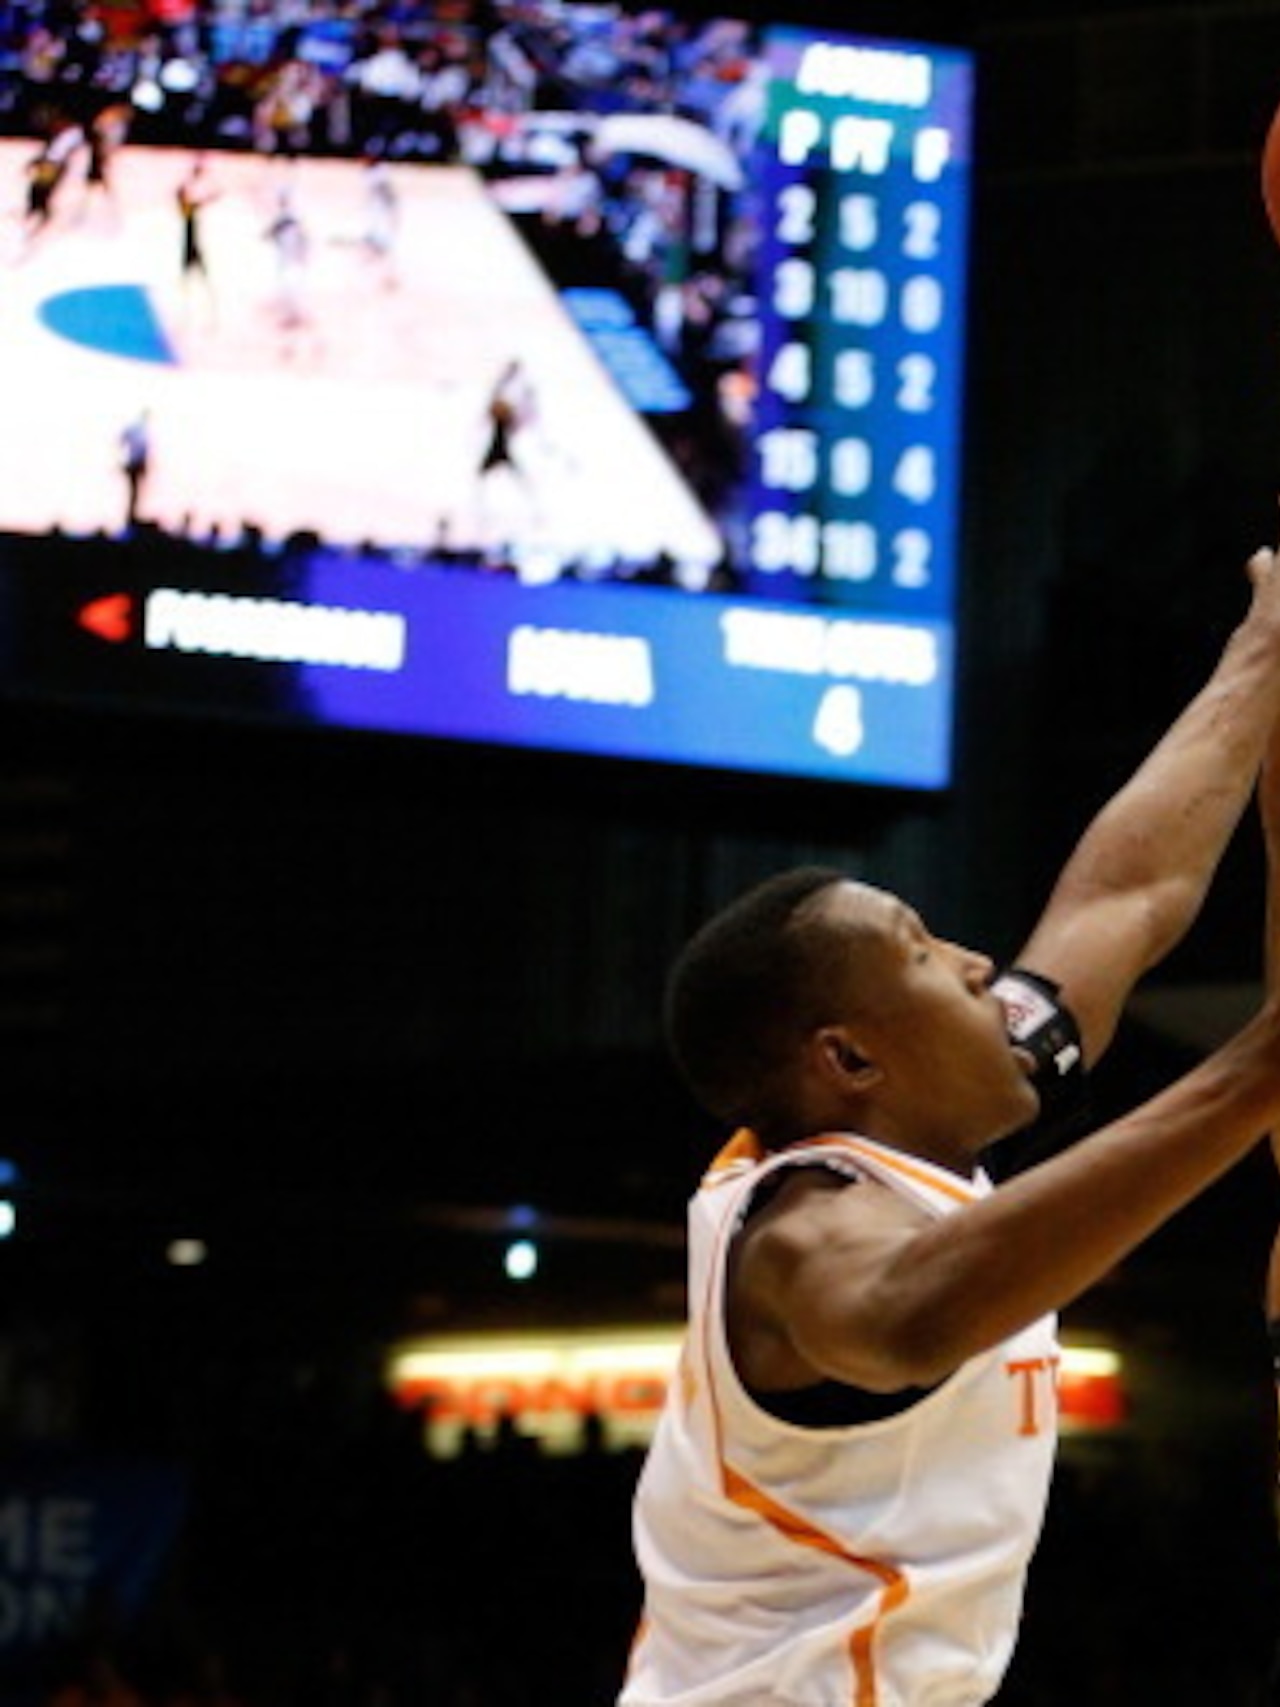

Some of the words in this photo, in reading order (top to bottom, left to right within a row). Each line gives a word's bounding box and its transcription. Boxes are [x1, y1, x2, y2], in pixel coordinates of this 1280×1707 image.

[777, 184, 816, 244] 2
[902, 201, 940, 258] 2
[767, 342, 810, 400] 4
[896, 354, 934, 412] 2
[894, 446, 934, 502] 4
[892, 528, 931, 588] 2
